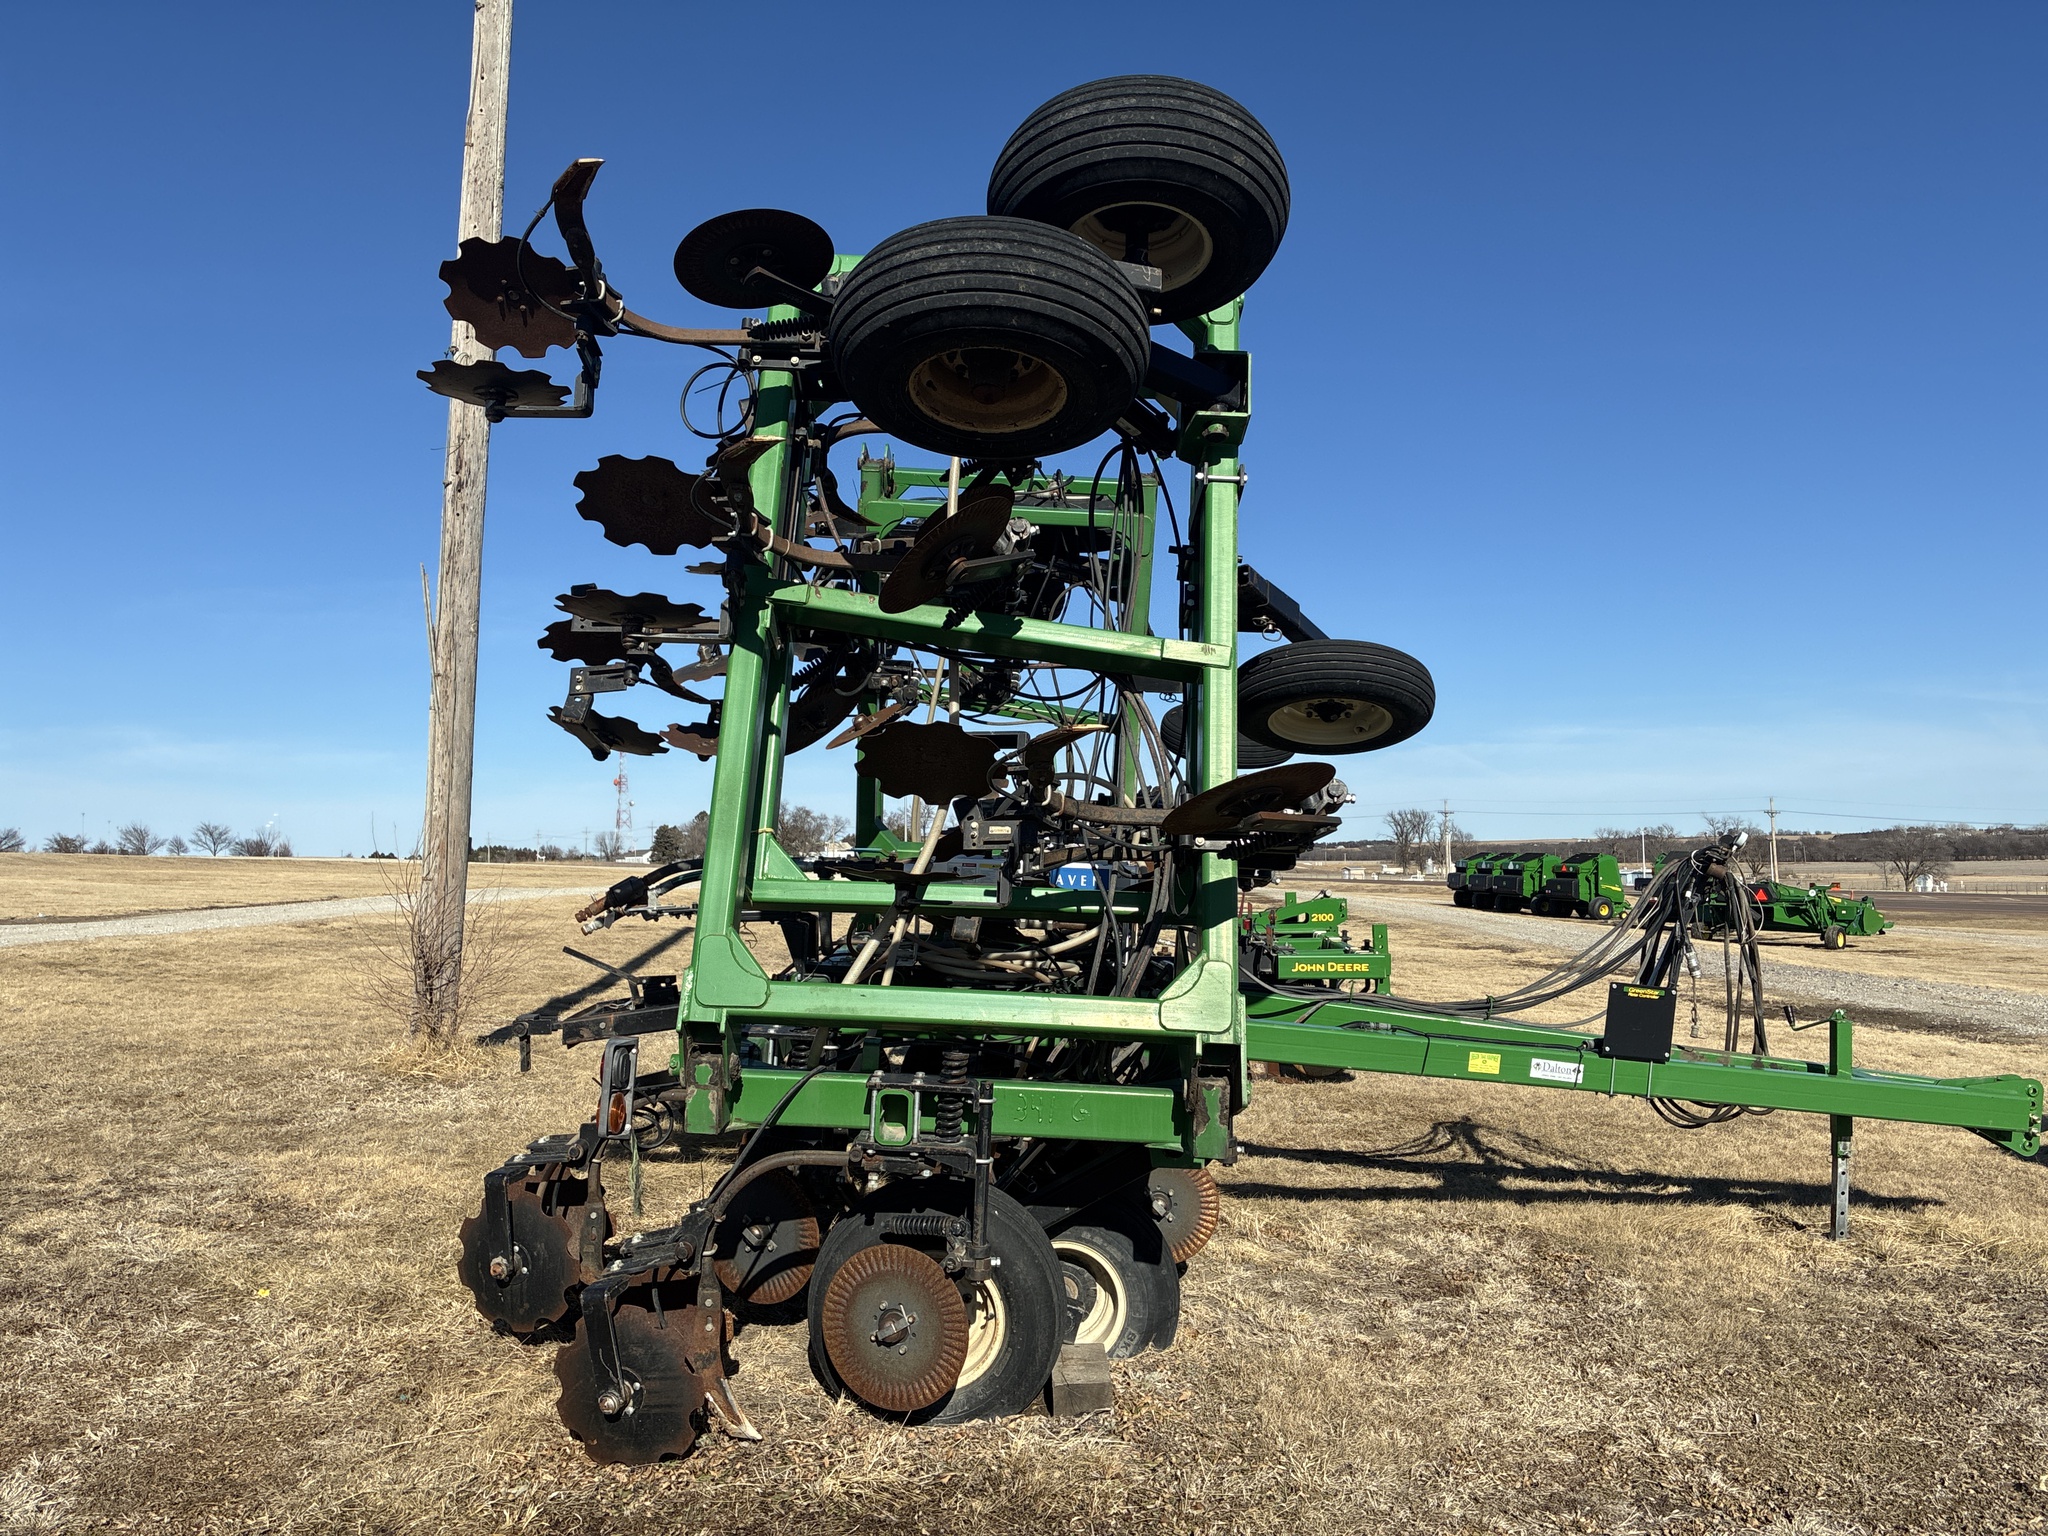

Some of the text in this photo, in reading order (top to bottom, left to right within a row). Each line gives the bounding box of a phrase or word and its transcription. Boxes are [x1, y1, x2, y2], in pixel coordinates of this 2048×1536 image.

[1311, 913, 1334, 922] 2100
[1291, 962, 1370, 972] JOHN DEERE
[1541, 1061, 1573, 1076] Dalton
